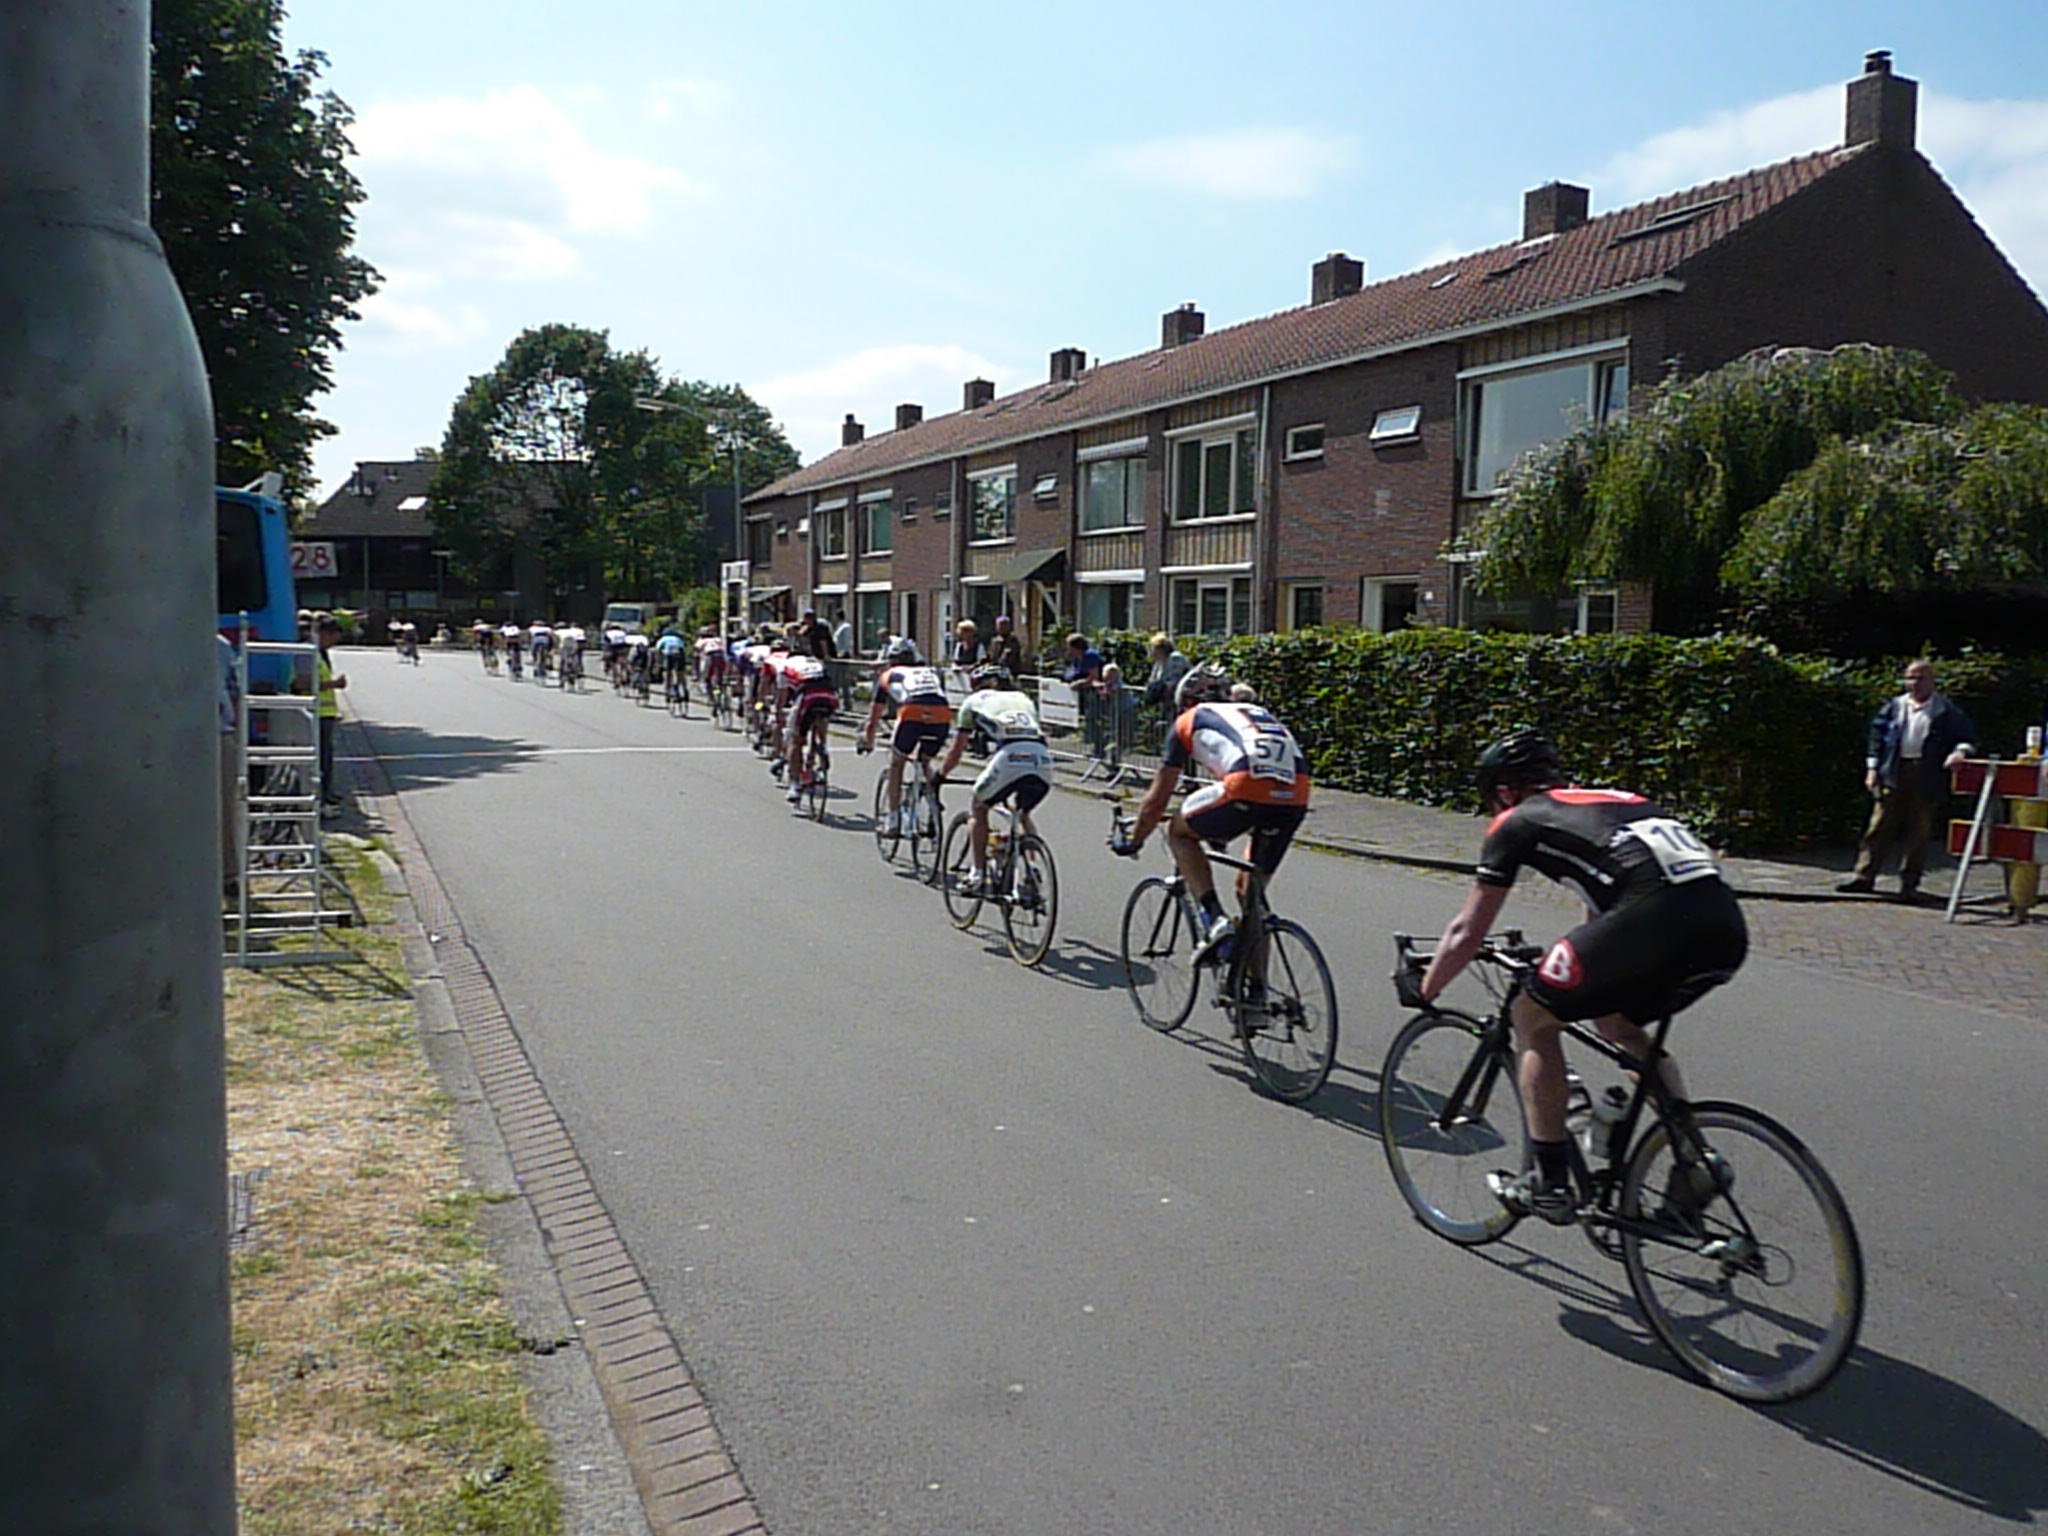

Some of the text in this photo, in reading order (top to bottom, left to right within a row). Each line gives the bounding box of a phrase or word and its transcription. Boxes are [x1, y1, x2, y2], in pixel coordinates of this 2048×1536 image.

[289, 545, 330, 571] 28
[1253, 737, 1286, 762] 57
[1541, 943, 1572, 982] B
